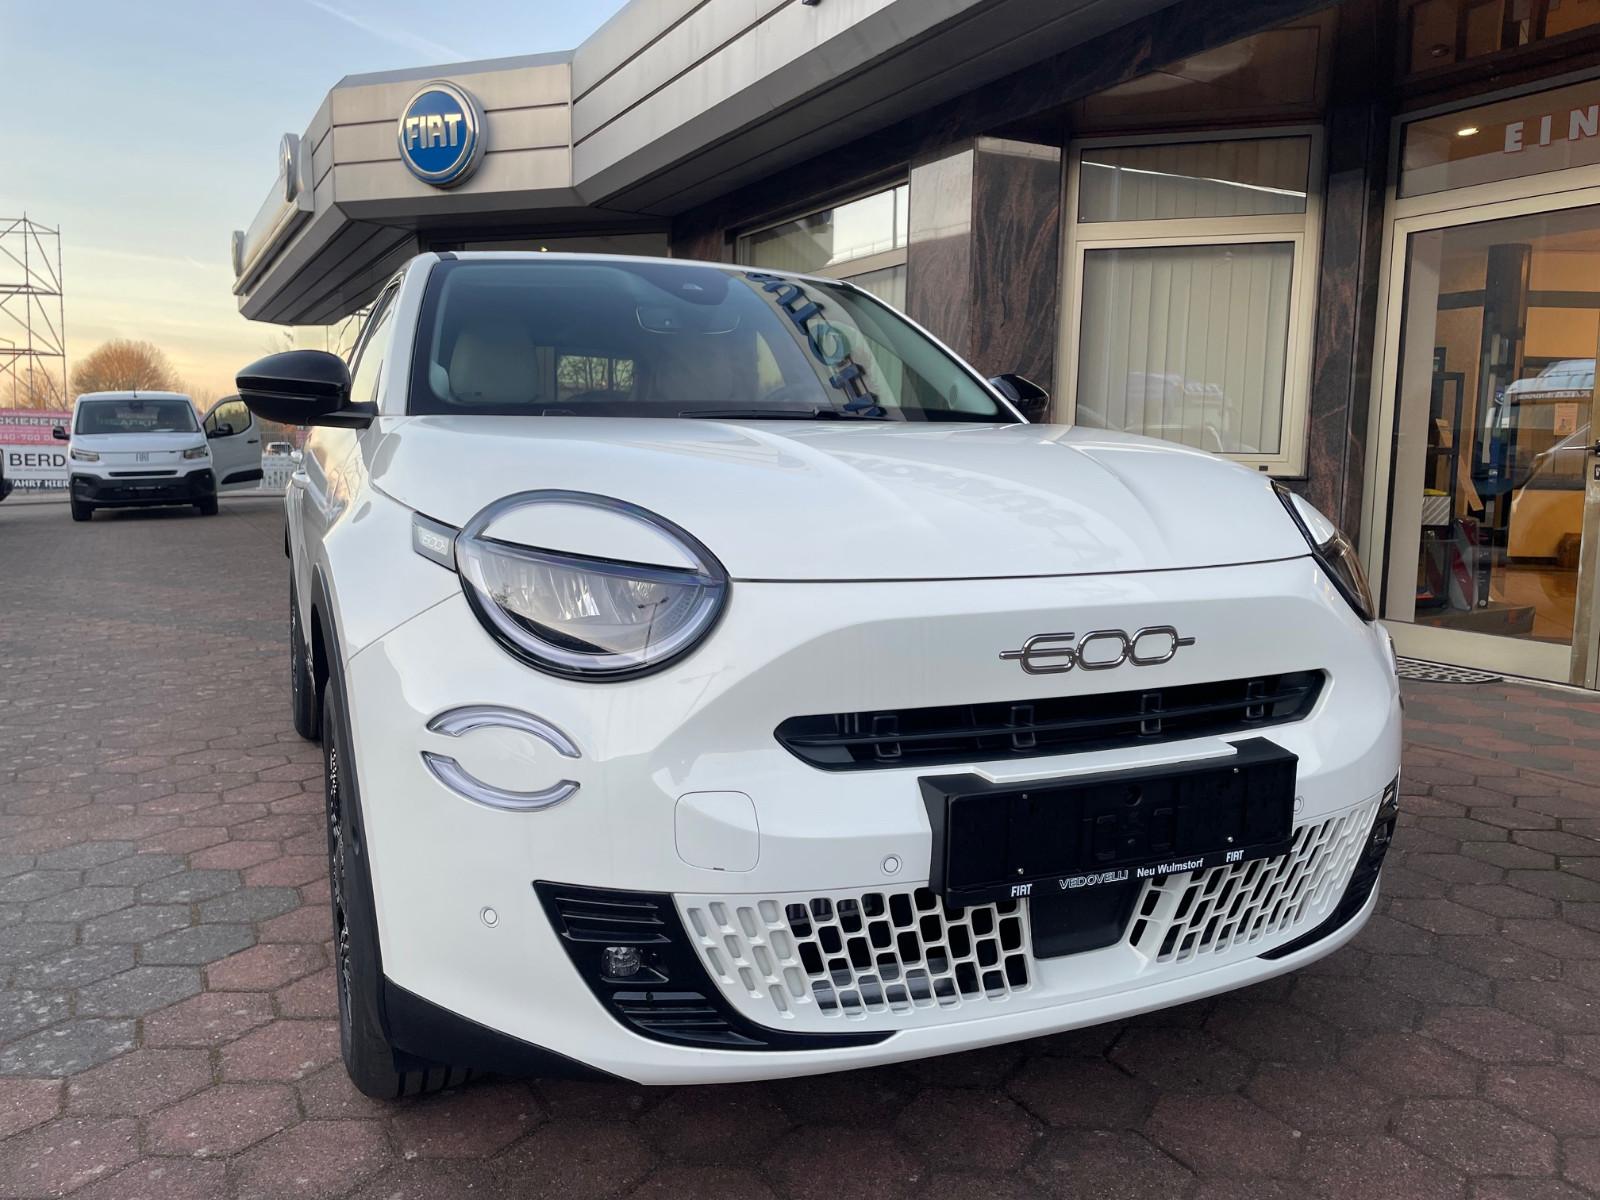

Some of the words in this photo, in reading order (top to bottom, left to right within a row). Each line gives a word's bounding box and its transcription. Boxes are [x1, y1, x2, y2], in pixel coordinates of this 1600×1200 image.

[406, 113, 462, 151] FIAT
[1503, 104, 1600, 154] EIN
[12, 479, 41, 488] AHRT
[999, 625, 1195, 675] 600
[1011, 884, 1032, 897] FIAT
[1059, 869, 1129, 889] VEDOVELLI
[1137, 867, 1155, 878] Neu
[1157, 858, 1204, 875] Wulmstorf
[1226, 850, 1244, 862] FIAT
